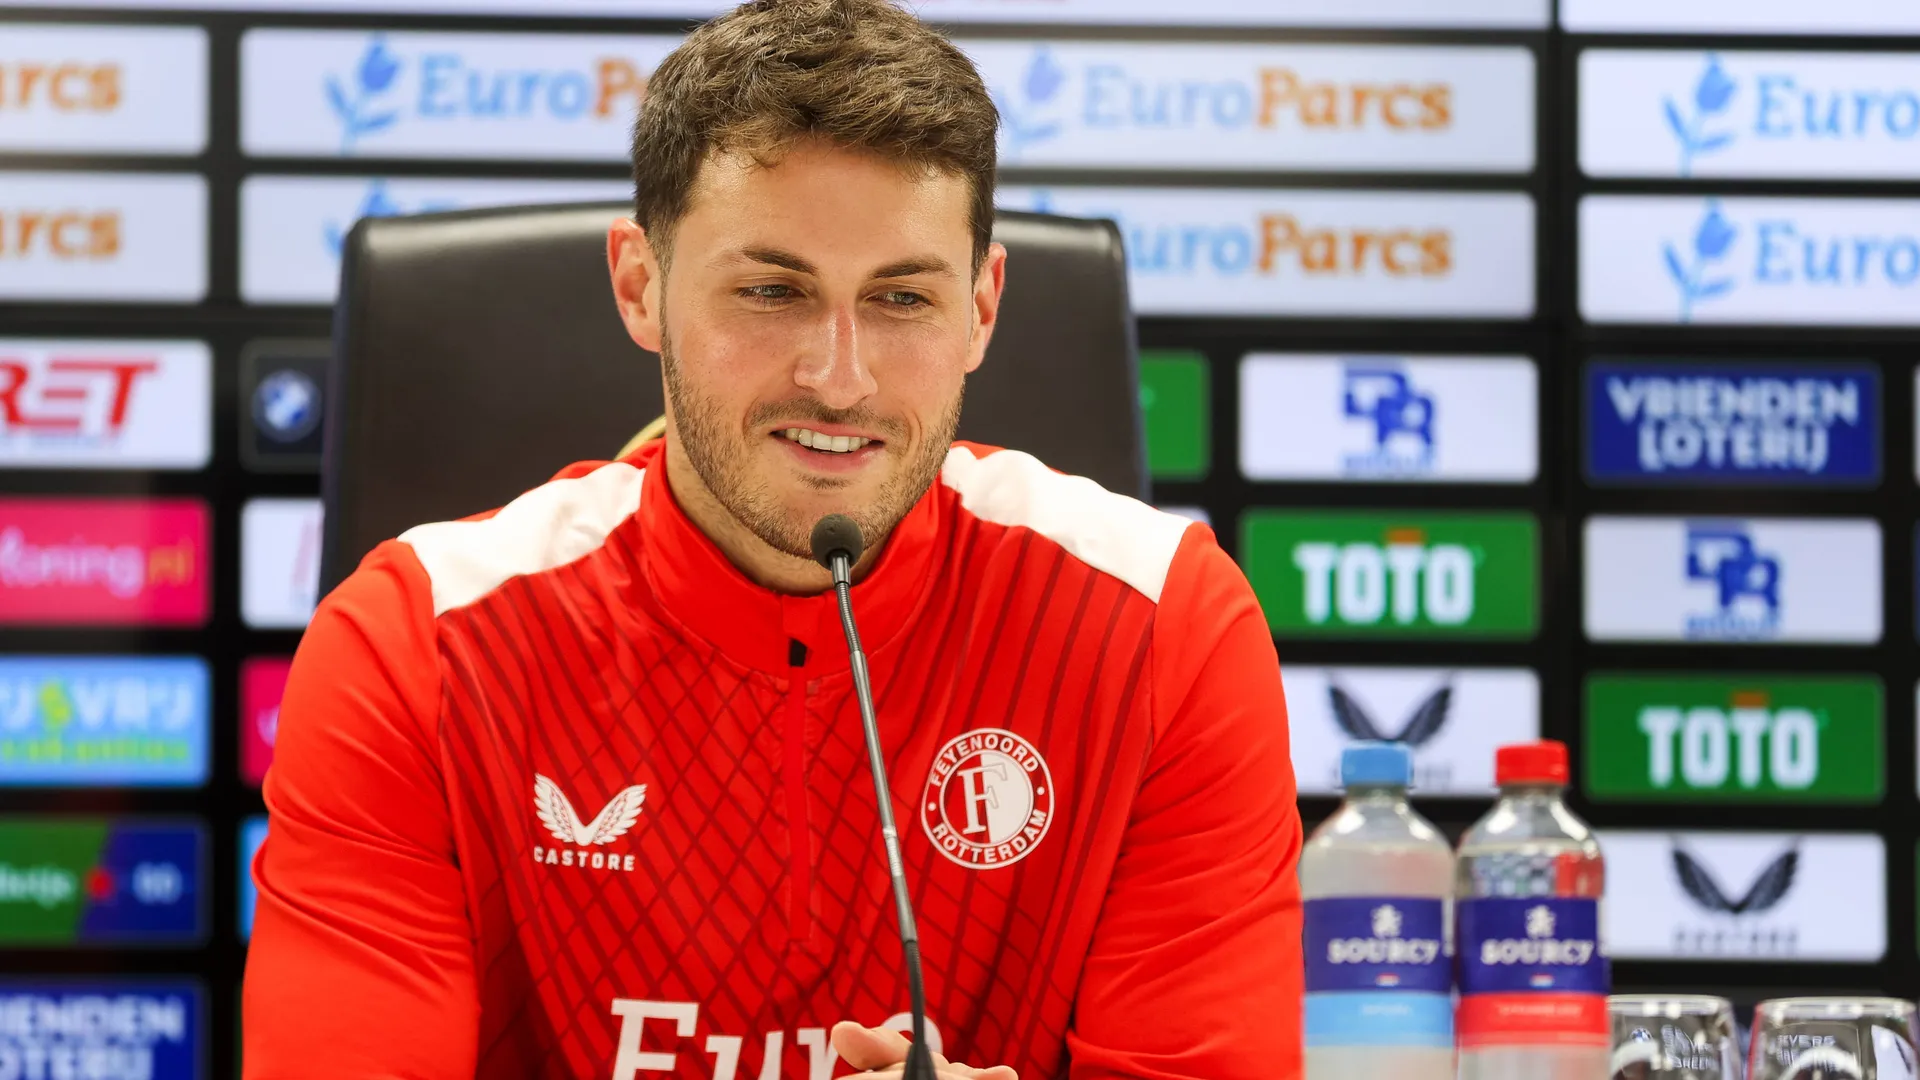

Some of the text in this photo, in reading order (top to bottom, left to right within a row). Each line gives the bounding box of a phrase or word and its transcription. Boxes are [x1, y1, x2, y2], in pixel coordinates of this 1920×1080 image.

[0, 60, 122, 112] rcs
[1083, 65, 1453, 130] EuroParcs
[1755, 76, 1920, 138] Euro
[0, 208, 122, 259] rcs
[1097, 210, 1453, 276] uroParcs
[1755, 222, 1920, 285] Euro
[1606, 376, 1859, 425] VRIENDEN
[1638, 420, 1828, 472] LOTERIJ
[1293, 541, 1475, 625] TOTO
[930, 733, 1040, 788] FEYENOORD
[1638, 706, 1820, 789] TOTO
[956, 762, 1009, 835] F
[533, 845, 636, 872] CASTORE
[932, 809, 1048, 864] ROTTERDAM
[1327, 938, 1440, 965] SOURCY
[1481, 938, 1594, 965] SOURCY
